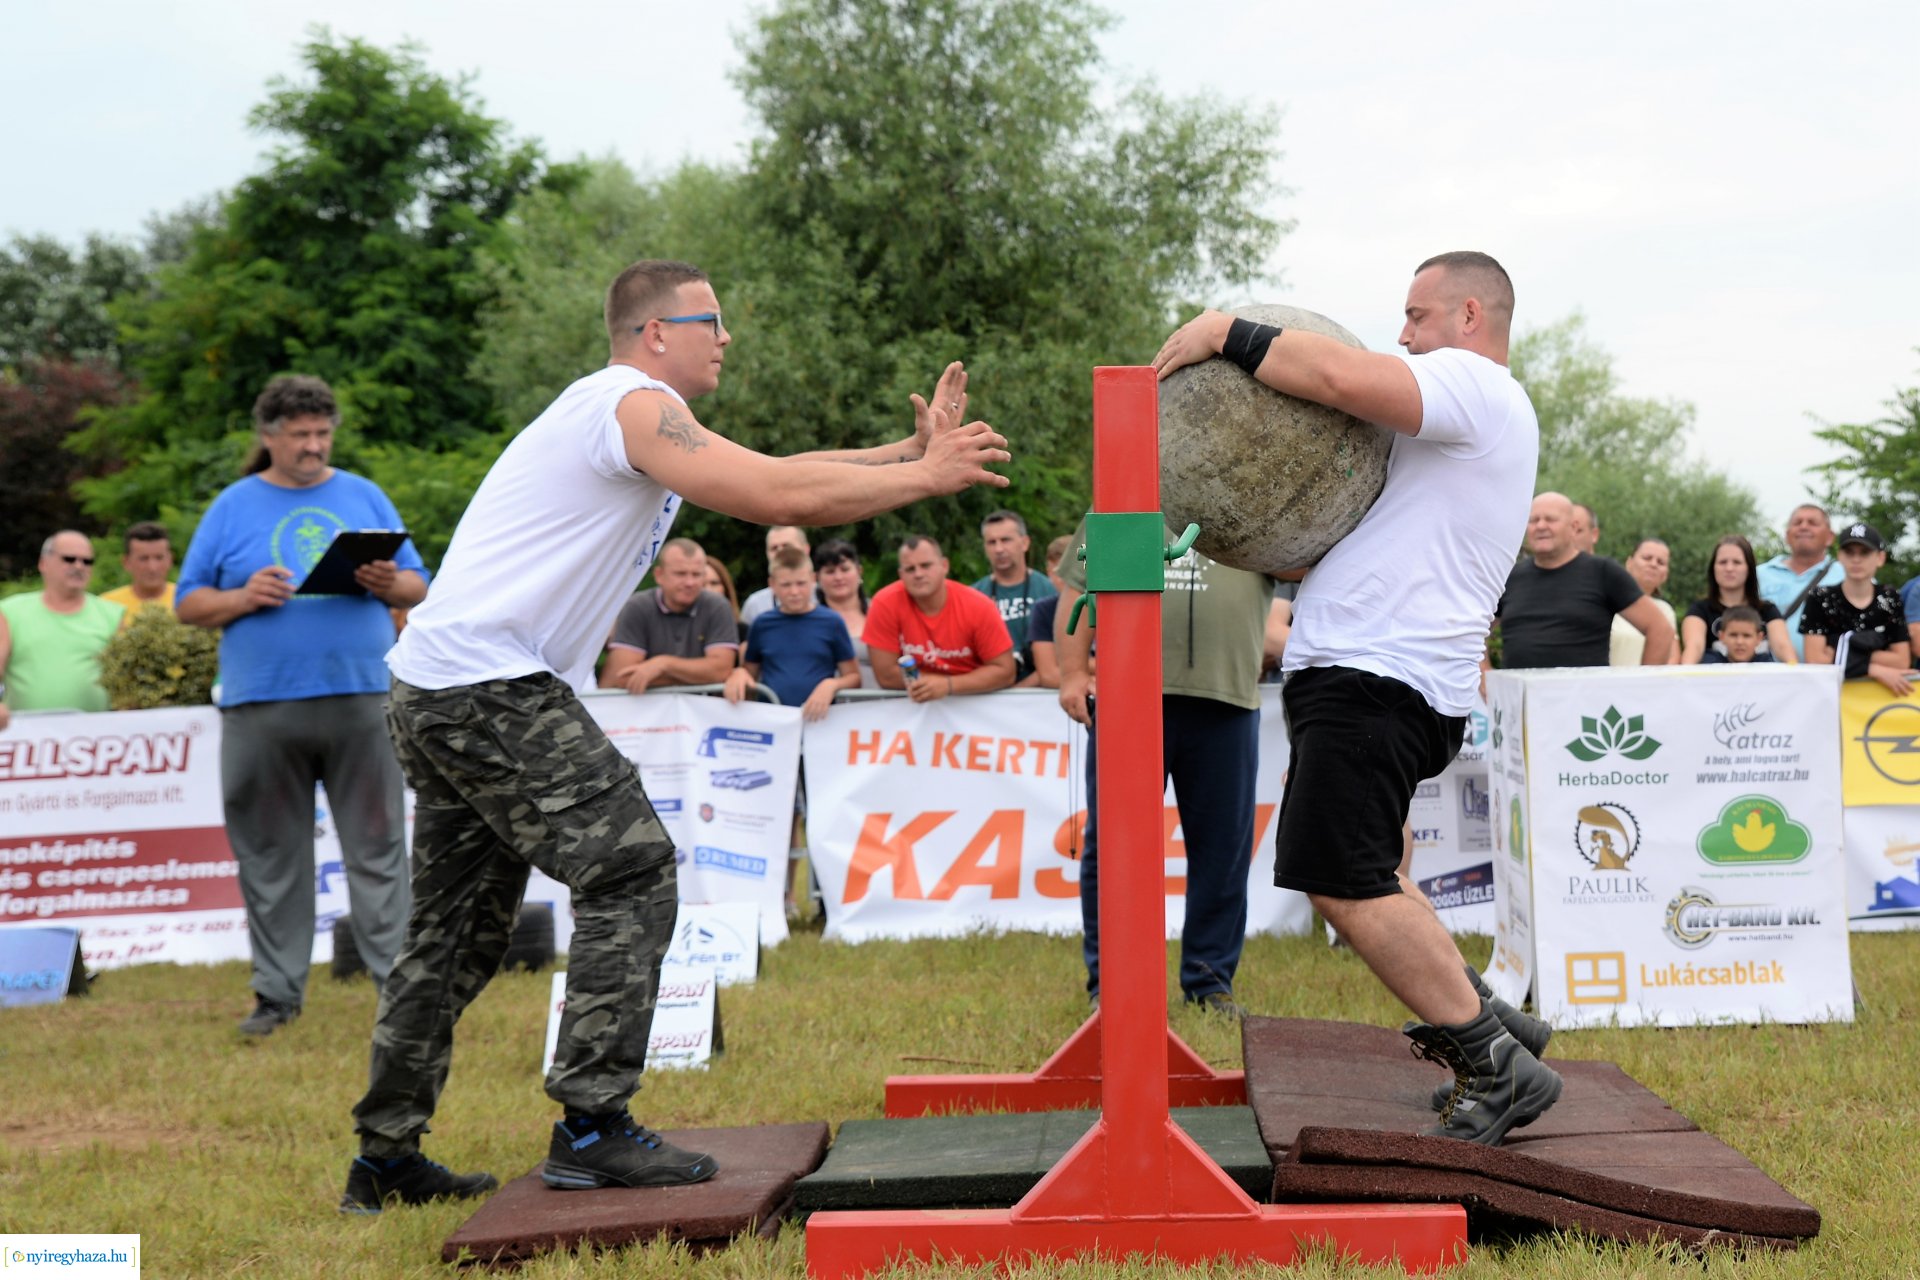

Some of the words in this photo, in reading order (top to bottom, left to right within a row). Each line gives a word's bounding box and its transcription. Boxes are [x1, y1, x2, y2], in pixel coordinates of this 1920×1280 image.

[1164, 582, 1209, 591] NGARY
[847, 729, 917, 766] HA
[931, 732, 1070, 779] KERTI
[1559, 771, 1669, 786] HerbaDoctor
[1697, 768, 1809, 783] www.halcatraz.hu
[1412, 828, 1444, 841] KFT.
[1464, 883, 1494, 905] ÜZLE
[1569, 876, 1650, 895] PAULIK
[1640, 960, 1785, 987] Lukácsablak
